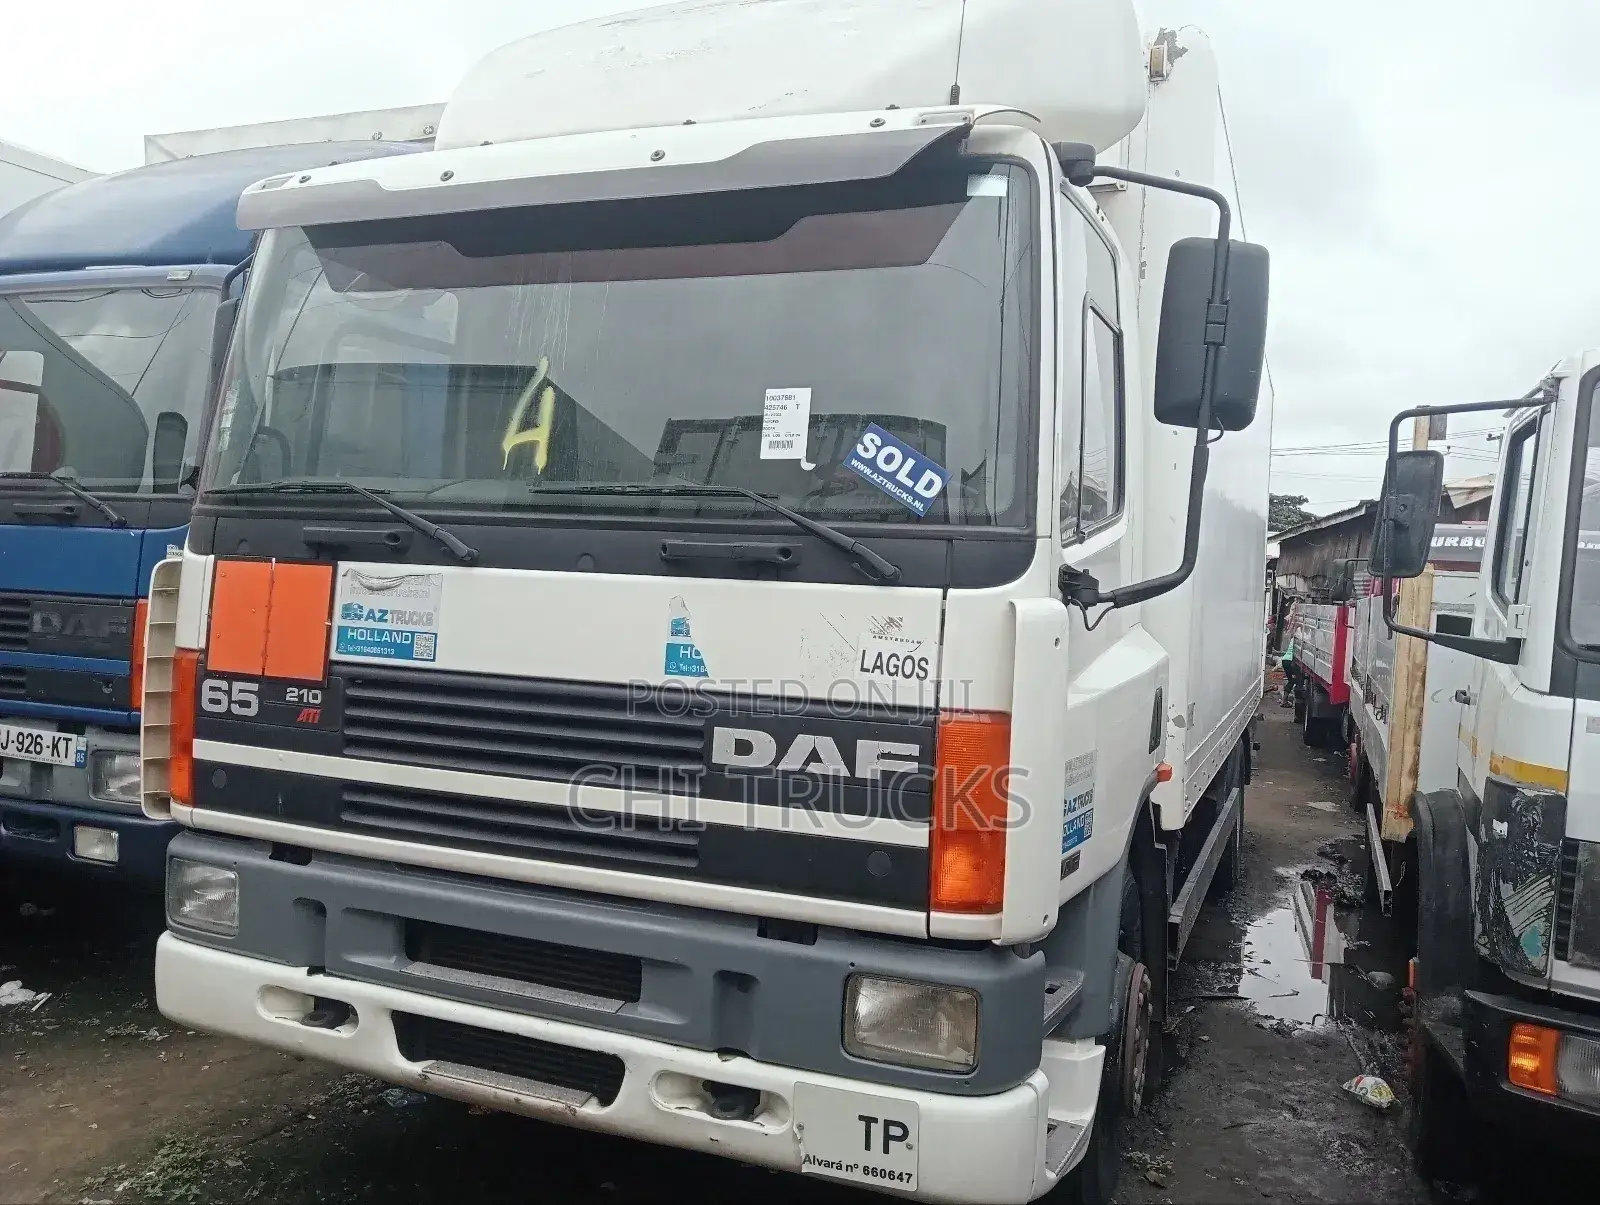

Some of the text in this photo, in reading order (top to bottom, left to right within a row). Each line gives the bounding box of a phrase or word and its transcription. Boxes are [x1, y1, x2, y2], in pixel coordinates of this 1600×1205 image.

[856, 432, 943, 499] SOLD
[850, 458, 924, 512] WWW.AZTRUCKS.NL
[1430, 536, 1486, 548] URBO
[32, 610, 129, 638] DAF
[347, 628, 412, 644] HOLLAND
[860, 649, 929, 681] LAGOS
[201, 678, 259, 717] 65
[285, 687, 322, 704] 210
[0, 729, 73, 760] J-926-KT
[76, 752, 85, 763] 85
[711, 726, 920, 779] DAF
[858, 1114, 910, 1155] TP
[802, 1153, 843, 1171] Alvará
[862, 1165, 913, 1184] 660647
